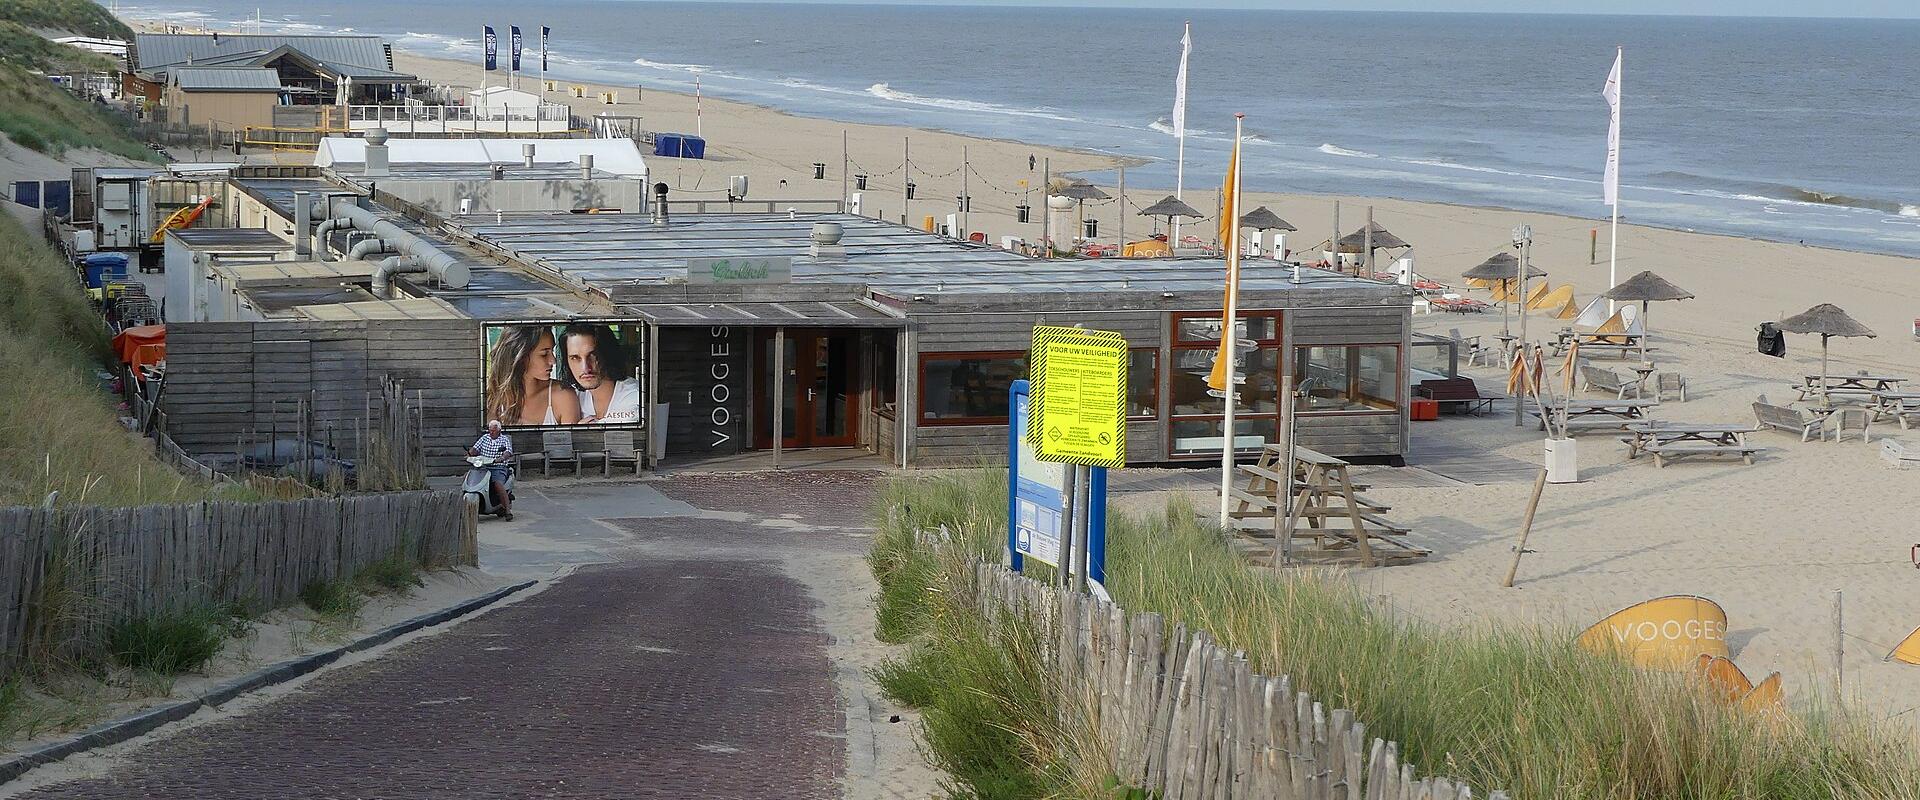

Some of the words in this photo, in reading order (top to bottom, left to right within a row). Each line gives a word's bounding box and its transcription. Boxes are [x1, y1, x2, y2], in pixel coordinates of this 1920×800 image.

[1049, 345, 1068, 354] VOOR
[1069, 347, 1080, 355] UW
[1080, 348, 1118, 358] VEILIGHEID
[711, 325, 730, 446] VOOGES
[1610, 619, 1724, 642] VOOGES
